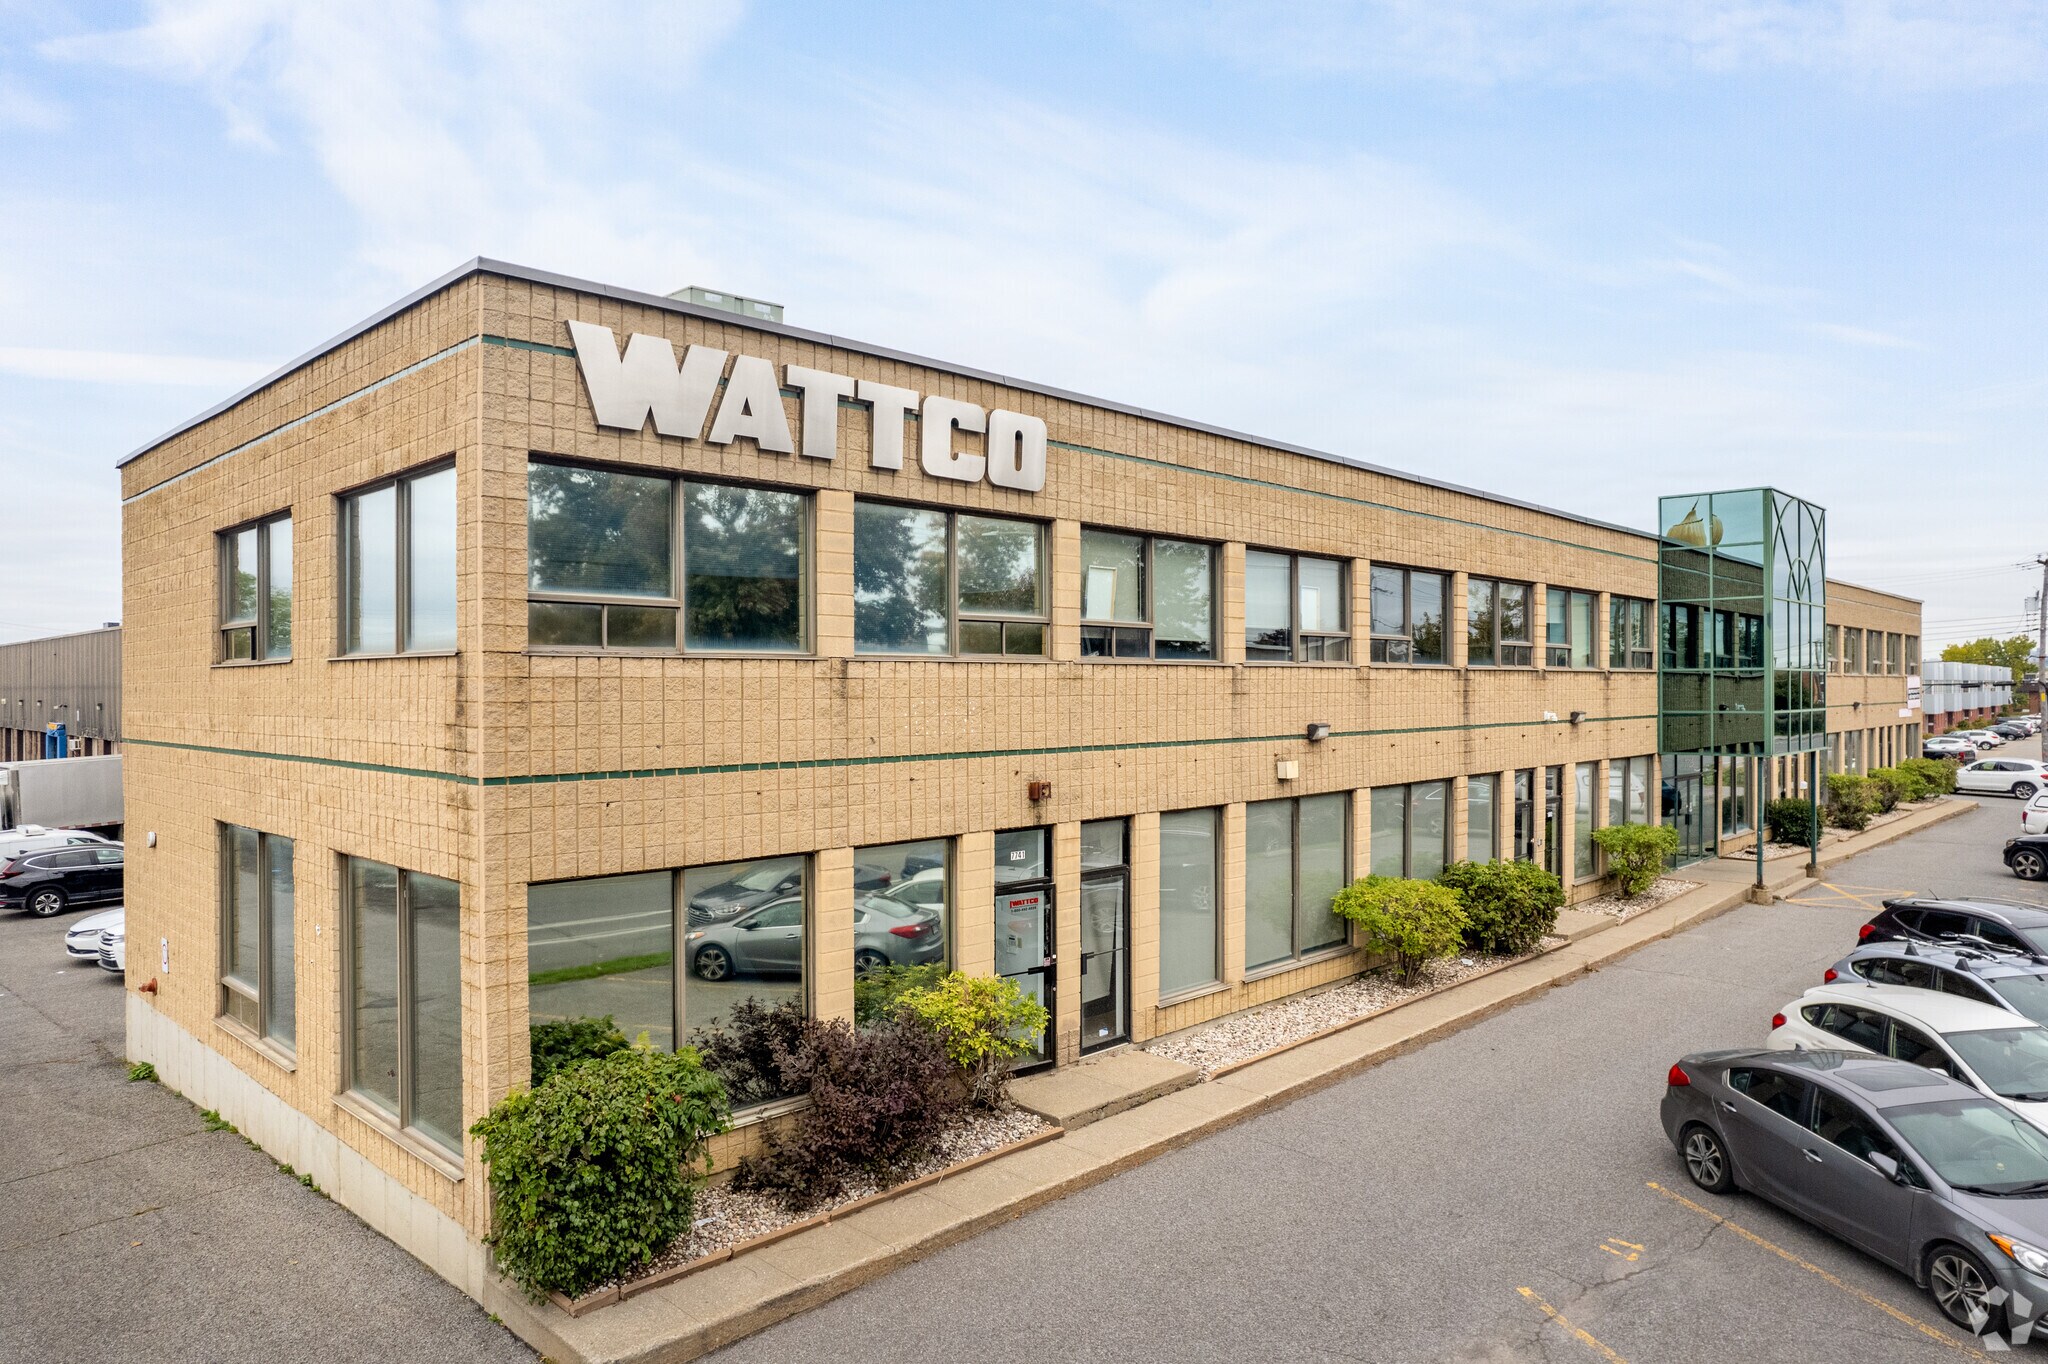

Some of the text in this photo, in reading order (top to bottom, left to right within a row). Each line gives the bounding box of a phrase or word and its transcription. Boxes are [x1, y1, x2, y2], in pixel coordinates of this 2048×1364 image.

[565, 319, 1048, 492] WATTCO
[1011, 851, 1025, 860] 7741
[1010, 898, 1038, 908] WATTCO
